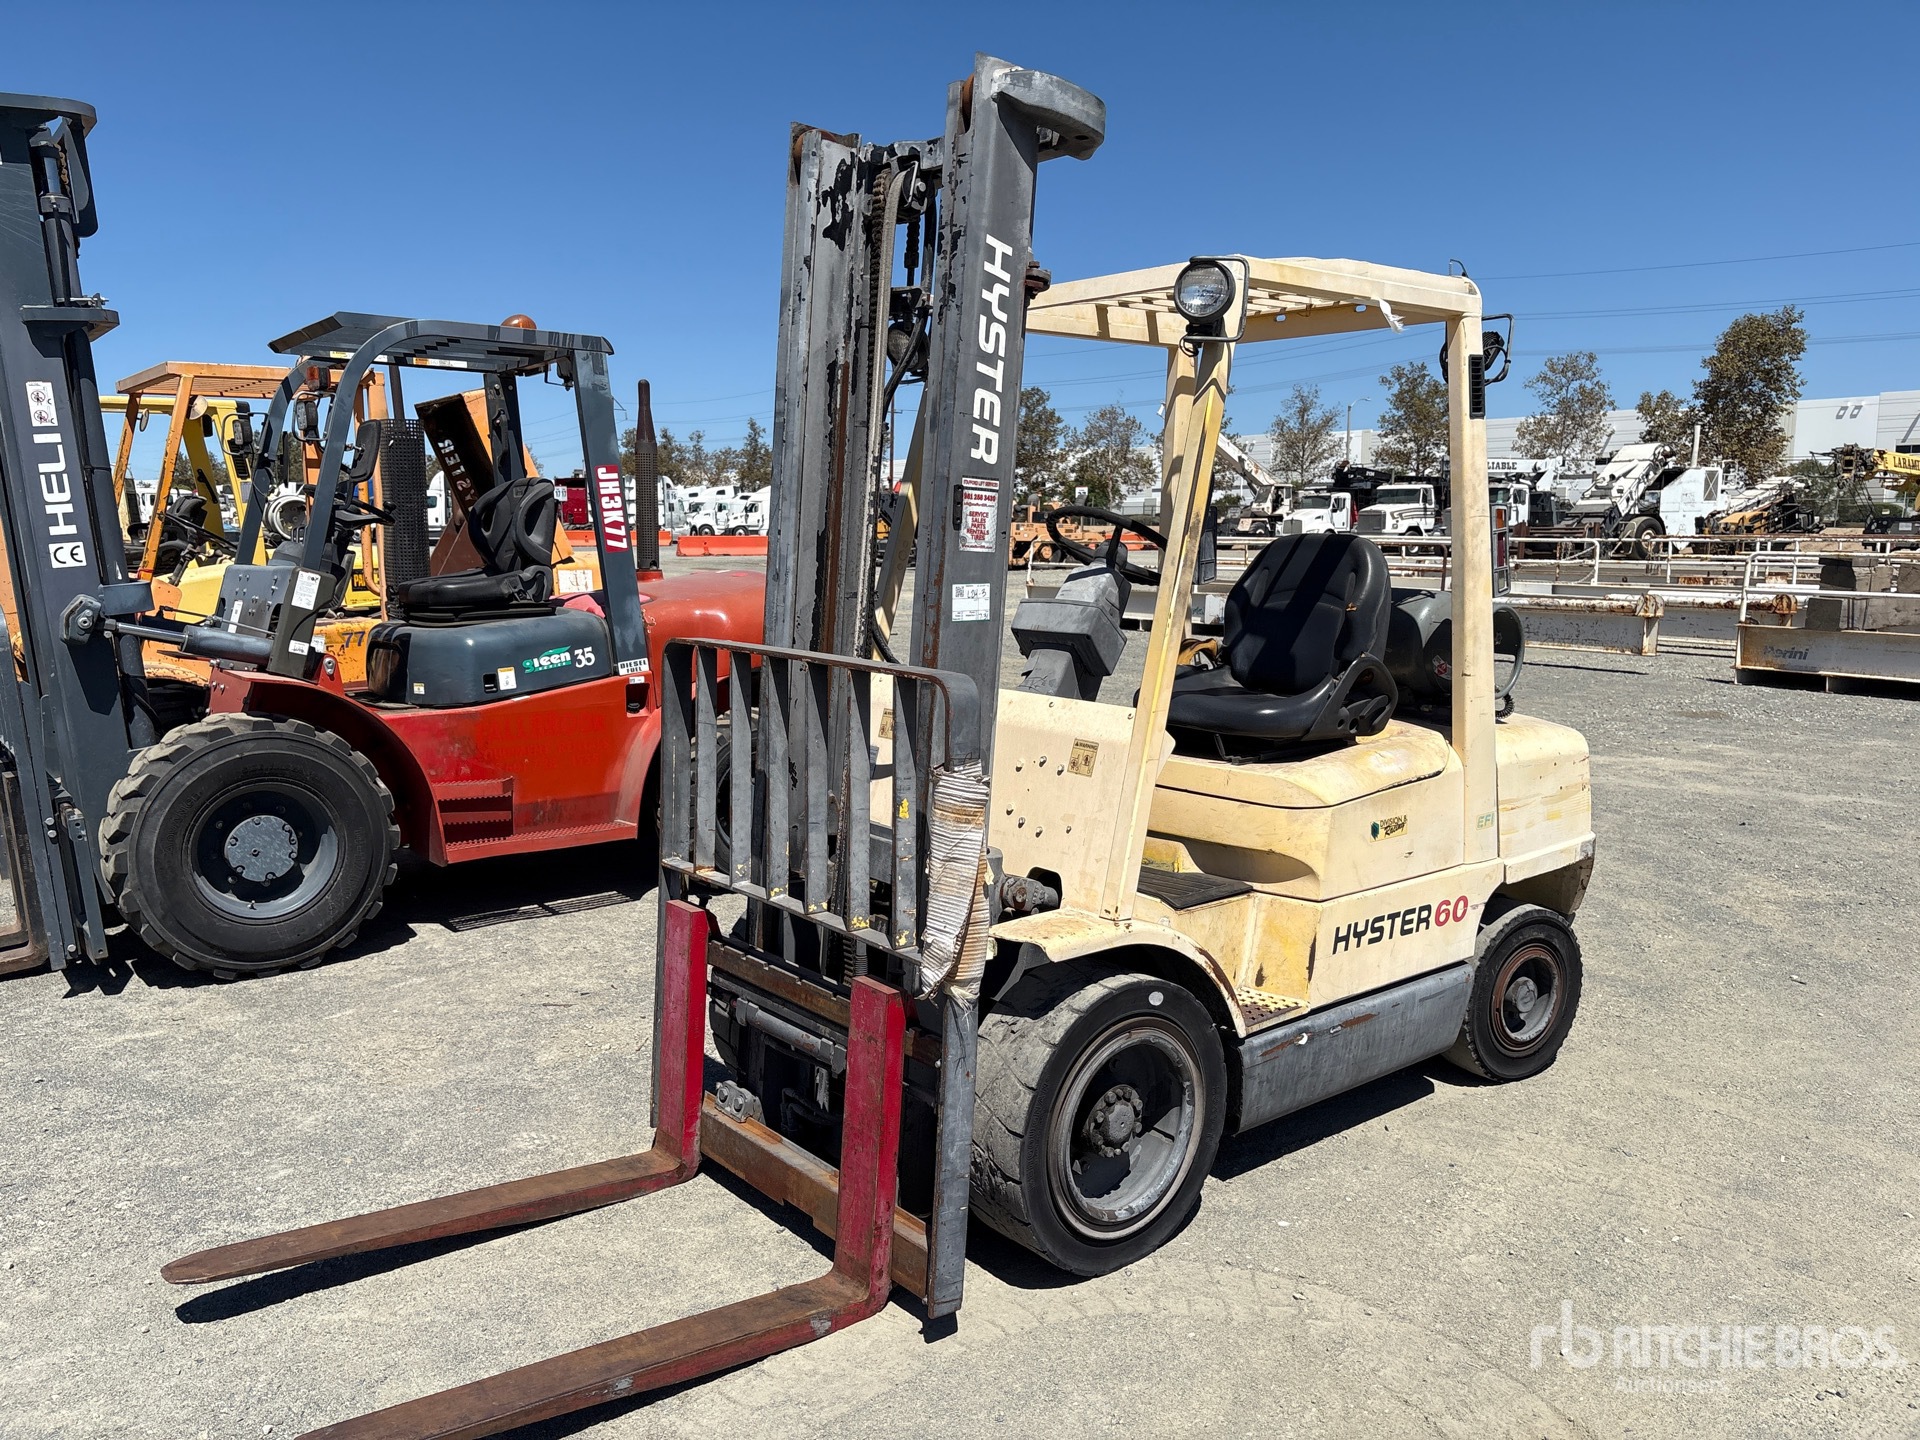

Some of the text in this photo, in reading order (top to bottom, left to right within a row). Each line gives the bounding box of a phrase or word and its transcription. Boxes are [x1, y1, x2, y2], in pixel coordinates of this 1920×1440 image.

[970, 233, 1013, 465] HYSTER
[33, 433, 78, 536] HELI
[597, 467, 628, 549] JH3K77
[53, 545, 83, 564] CE
[341, 631, 366, 648] 77
[574, 646, 595, 668] 35
[620, 659, 647, 669] DIESEL
[1332, 895, 1469, 955] HYSTER 60
